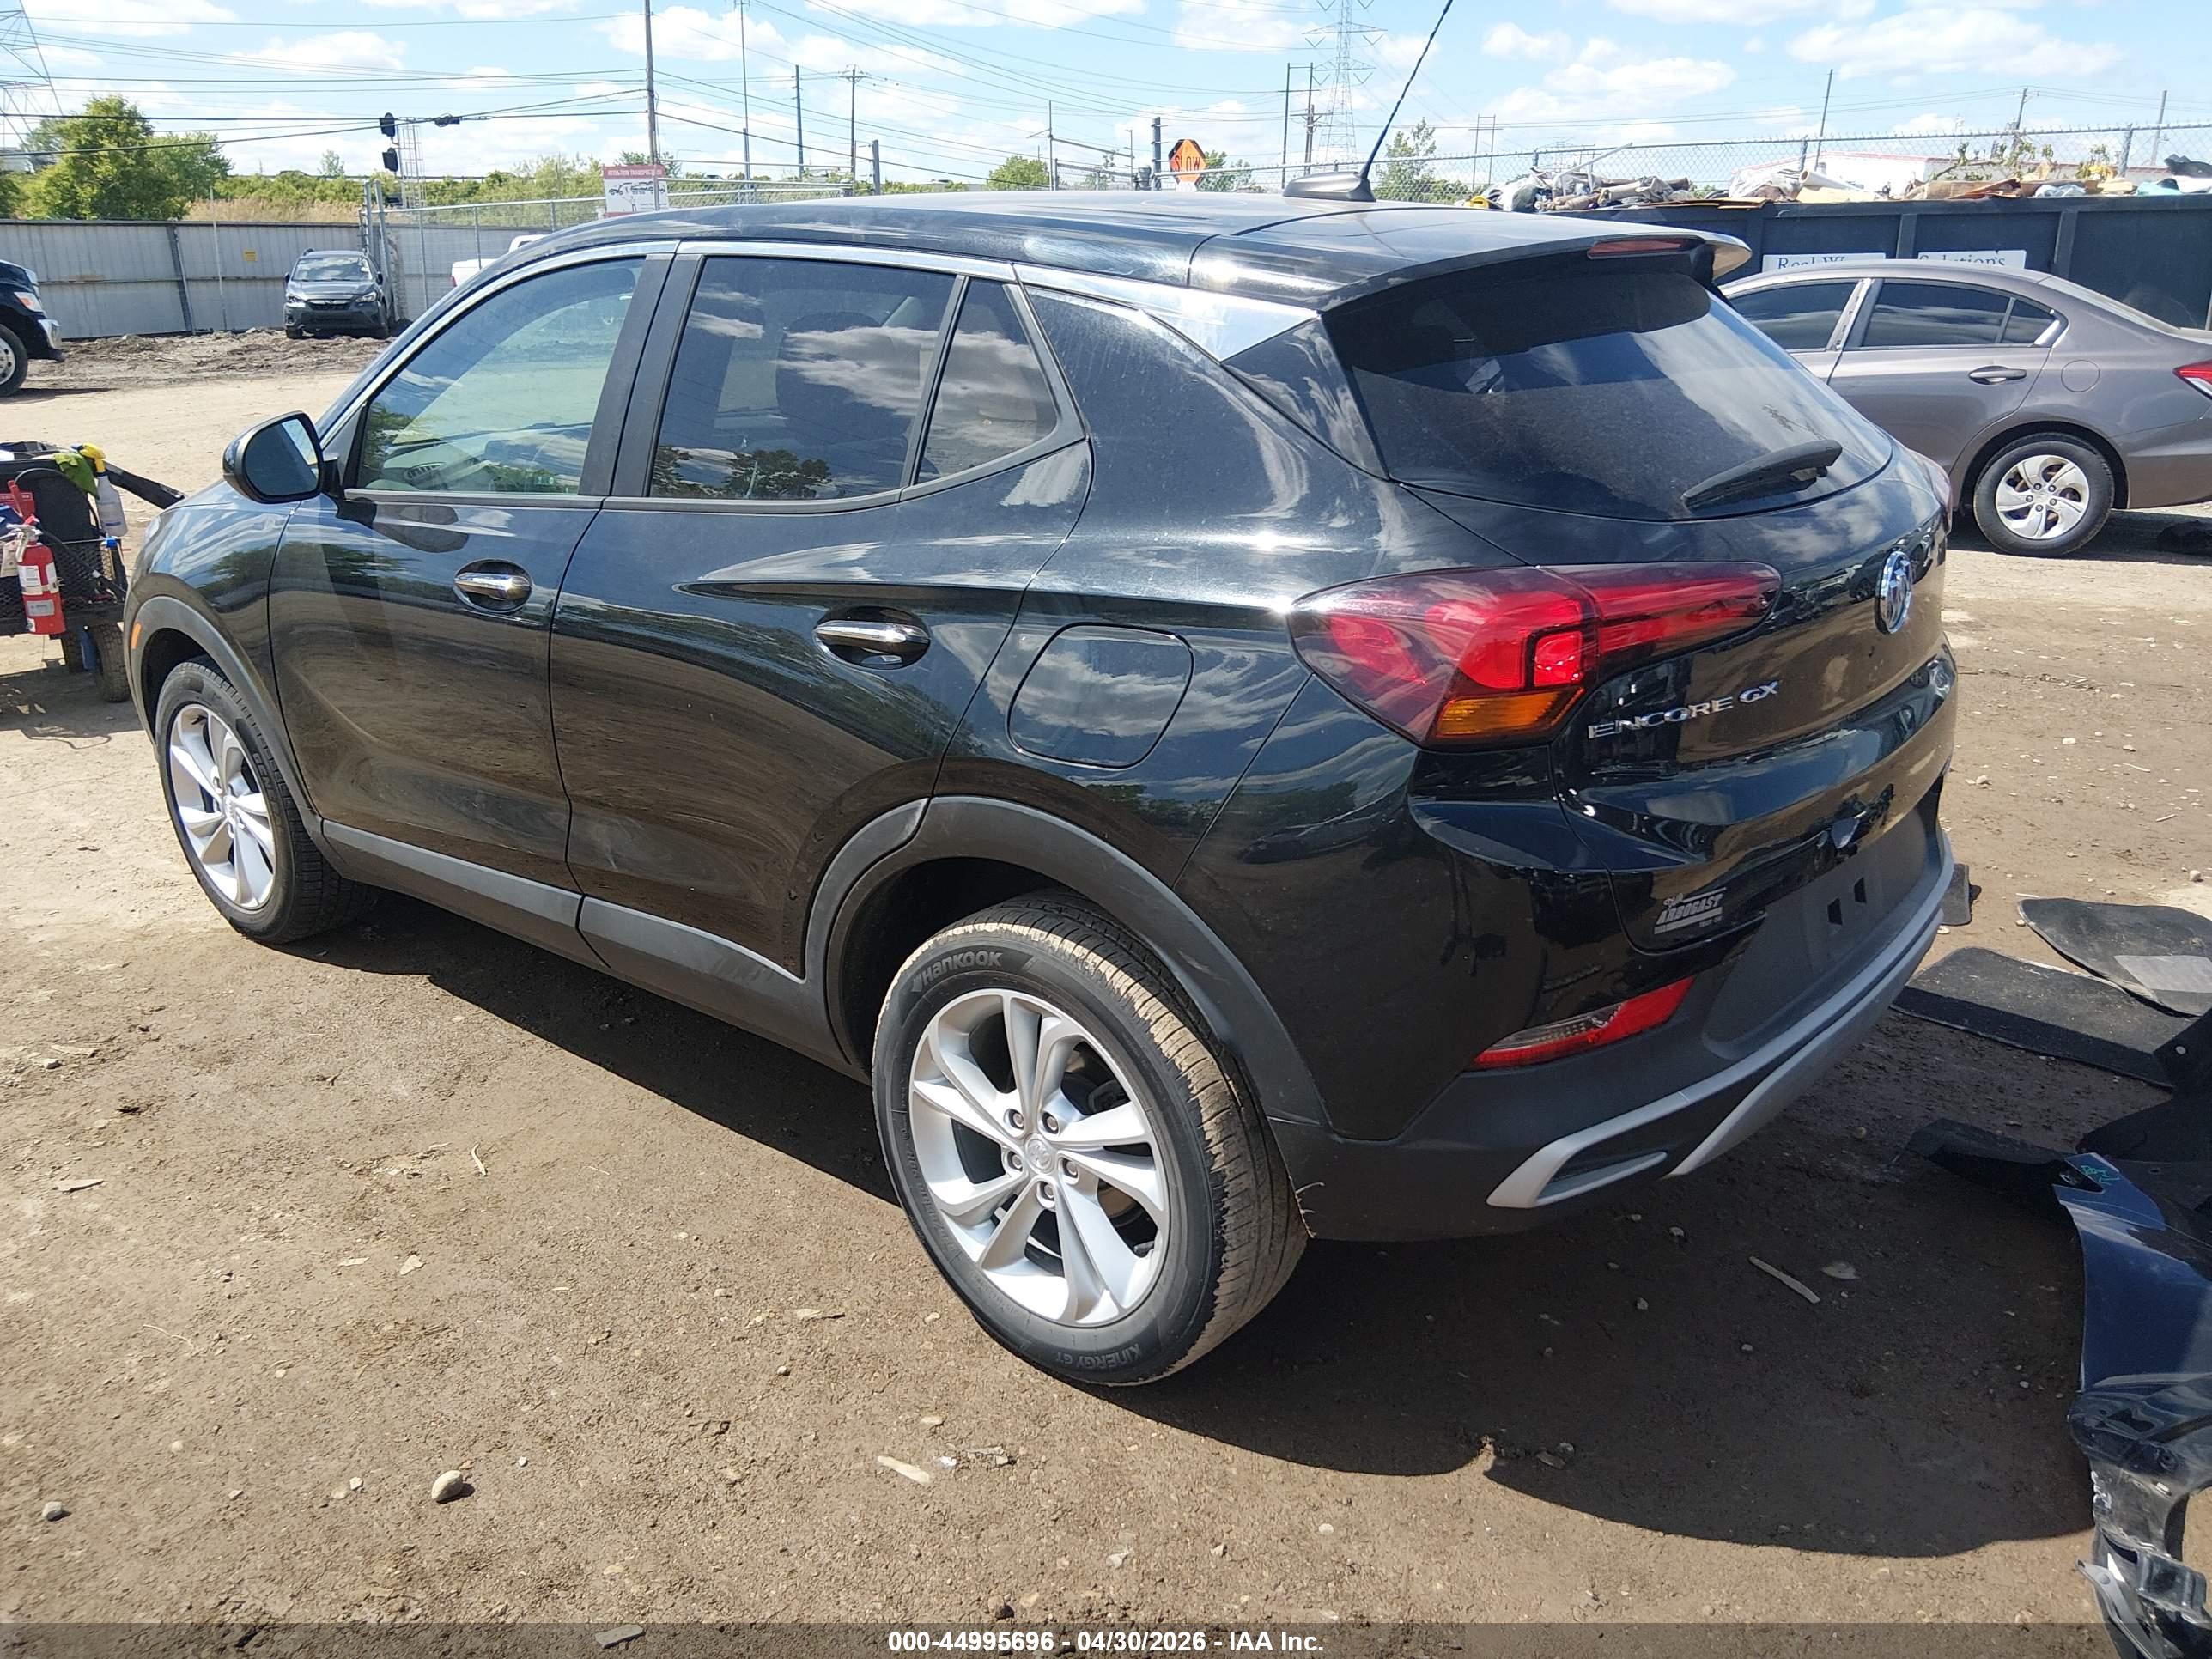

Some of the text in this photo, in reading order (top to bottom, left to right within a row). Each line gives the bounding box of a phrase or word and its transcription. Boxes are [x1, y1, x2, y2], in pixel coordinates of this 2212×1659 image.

[1175, 155, 1200, 172] SLOW
[1588, 680, 1781, 739] ENCORE GX
[1656, 893, 1723, 925] ARBOGAST
